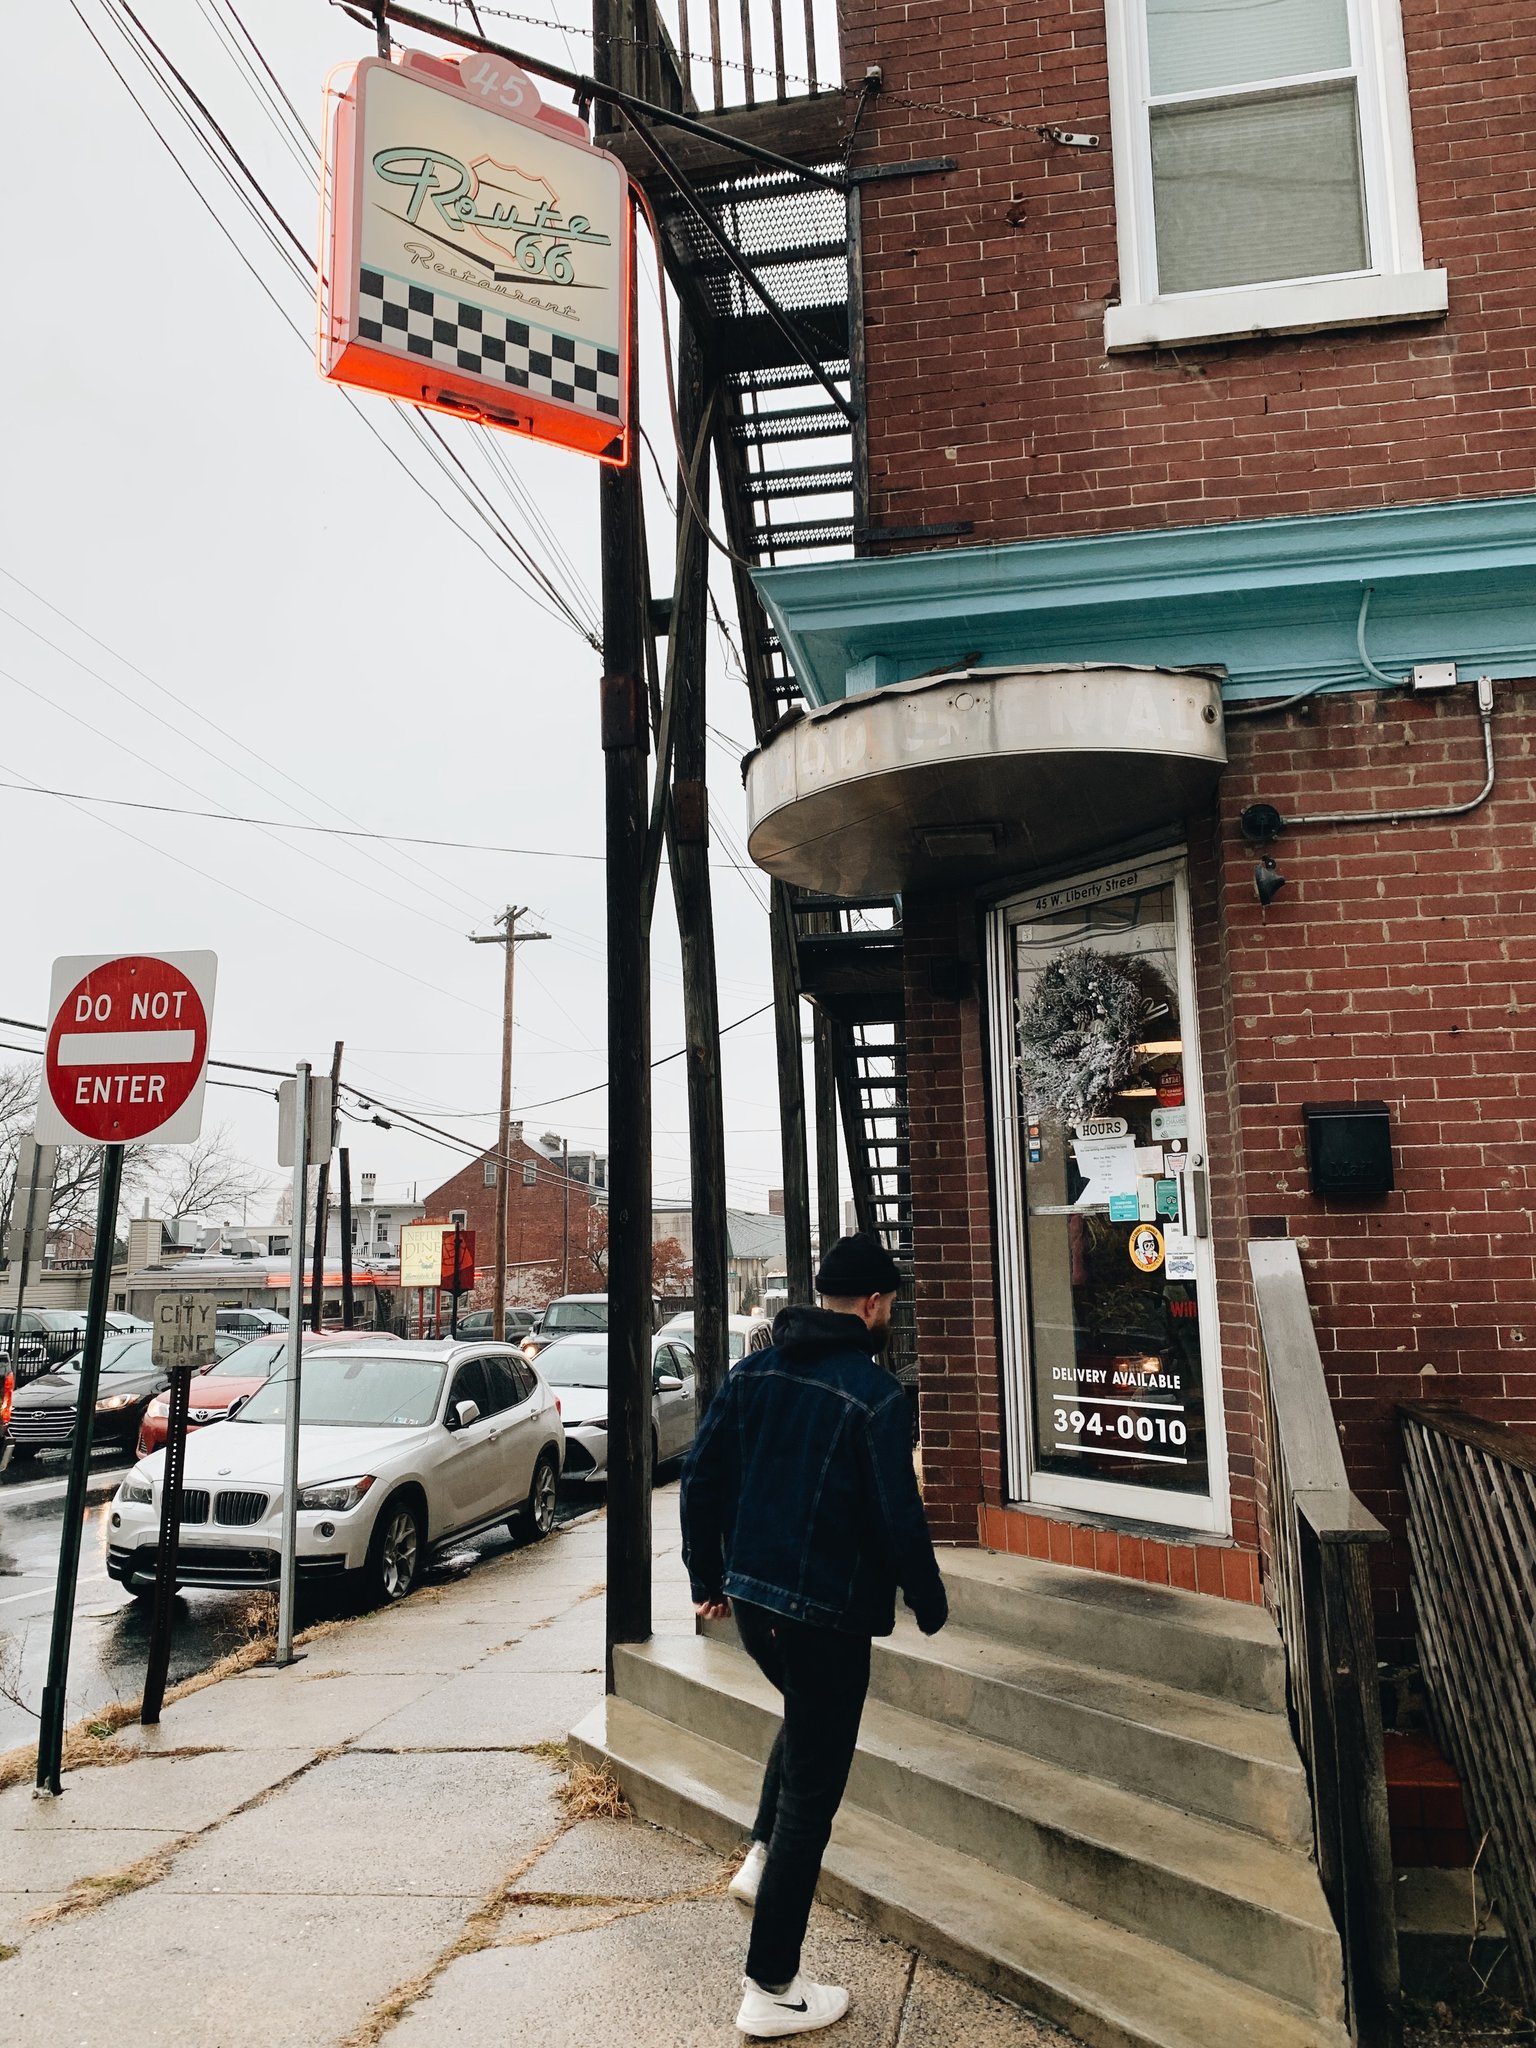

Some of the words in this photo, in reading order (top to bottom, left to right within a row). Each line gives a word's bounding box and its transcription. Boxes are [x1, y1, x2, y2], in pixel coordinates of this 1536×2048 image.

[470, 62, 525, 107] 45
[373, 147, 612, 245] Route
[514, 233, 574, 285] 66
[404, 241, 581, 321] Restaurant
[1036, 899, 1047, 910] 45
[1050, 896, 1063, 906] W.
[1066, 884, 1102, 902] Liberty
[1105, 873, 1138, 892] Street
[75, 994, 112, 1022] DO
[130, 991, 188, 1020] NOT
[75, 1075, 166, 1104] ENTER
[1082, 1121, 1121, 1136] HOURS
[405, 1242, 441, 1260] DINE
[160, 1305, 211, 1323] CITY
[1052, 1366, 1107, 1384] DELIVERY
[1112, 1371, 1181, 1390] AVAILABLE
[1053, 1408, 1187, 1446] 394-0010
